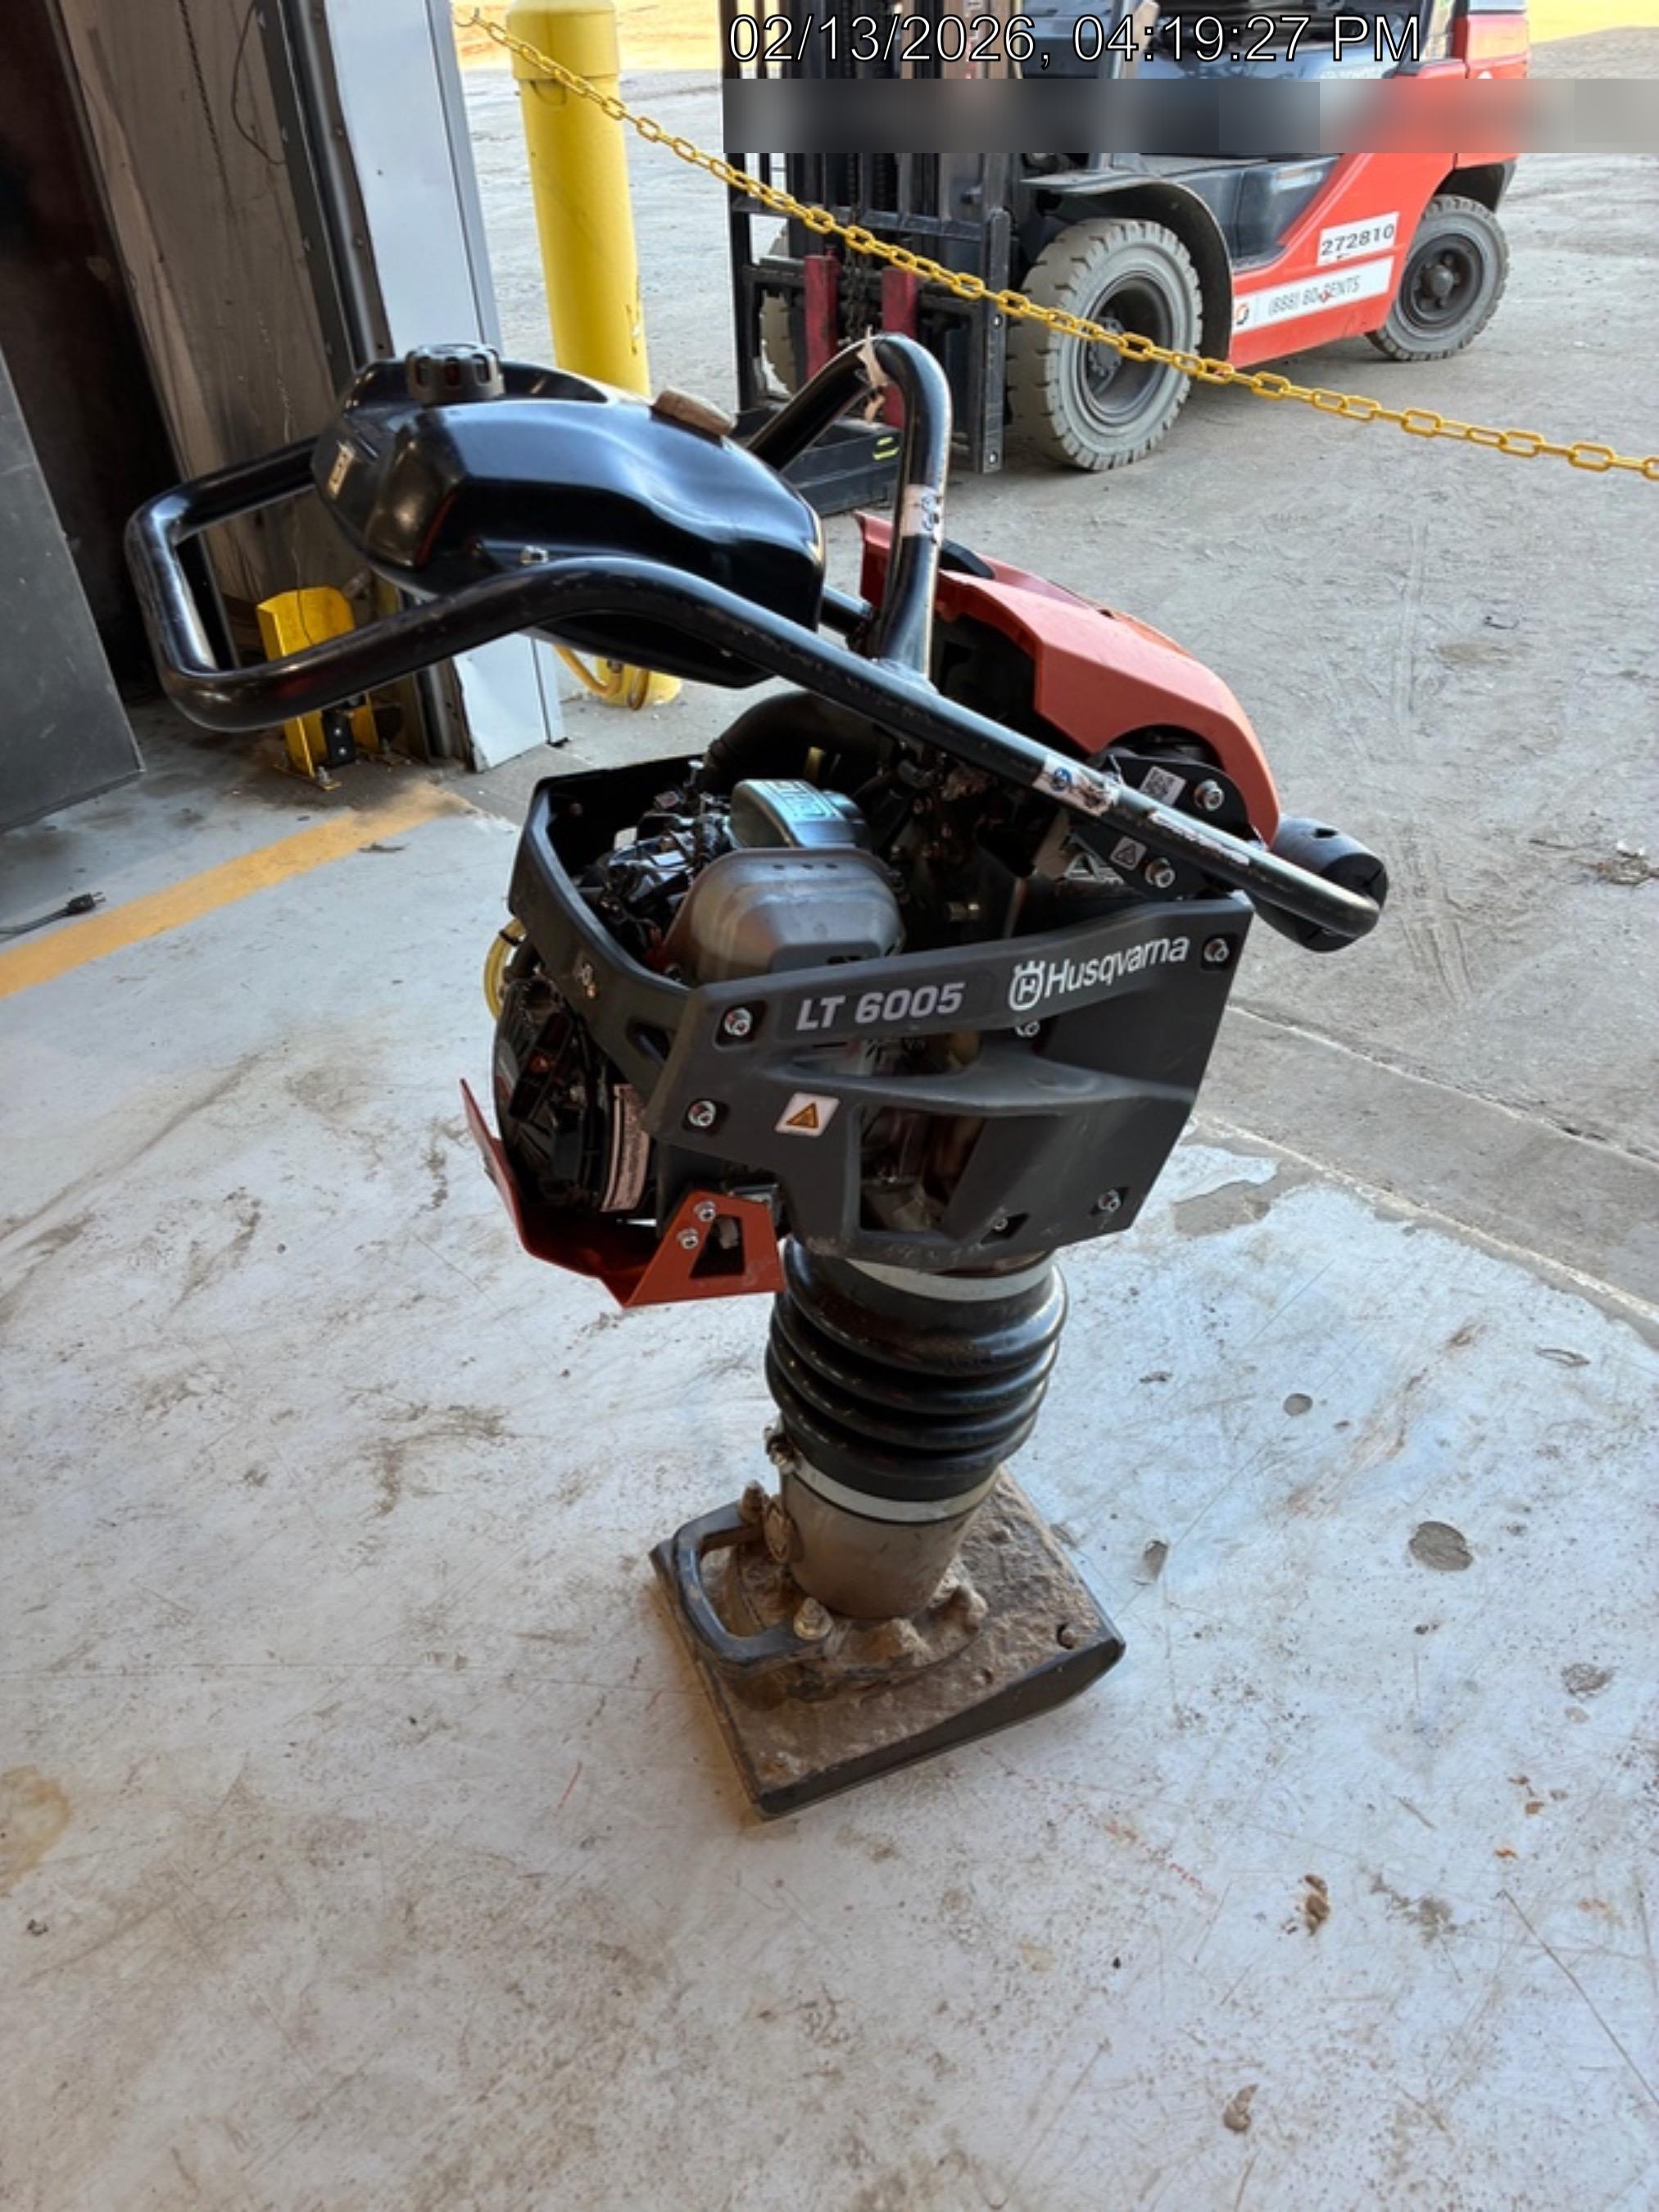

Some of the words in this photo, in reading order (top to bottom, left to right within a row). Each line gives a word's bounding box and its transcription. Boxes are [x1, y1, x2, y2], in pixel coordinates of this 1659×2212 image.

[1321, 223, 1394, 256] 272810
[1044, 936, 1190, 999] Husqvarna
[796, 995, 846, 1031] LT
[854, 982, 965, 1024] 6005
